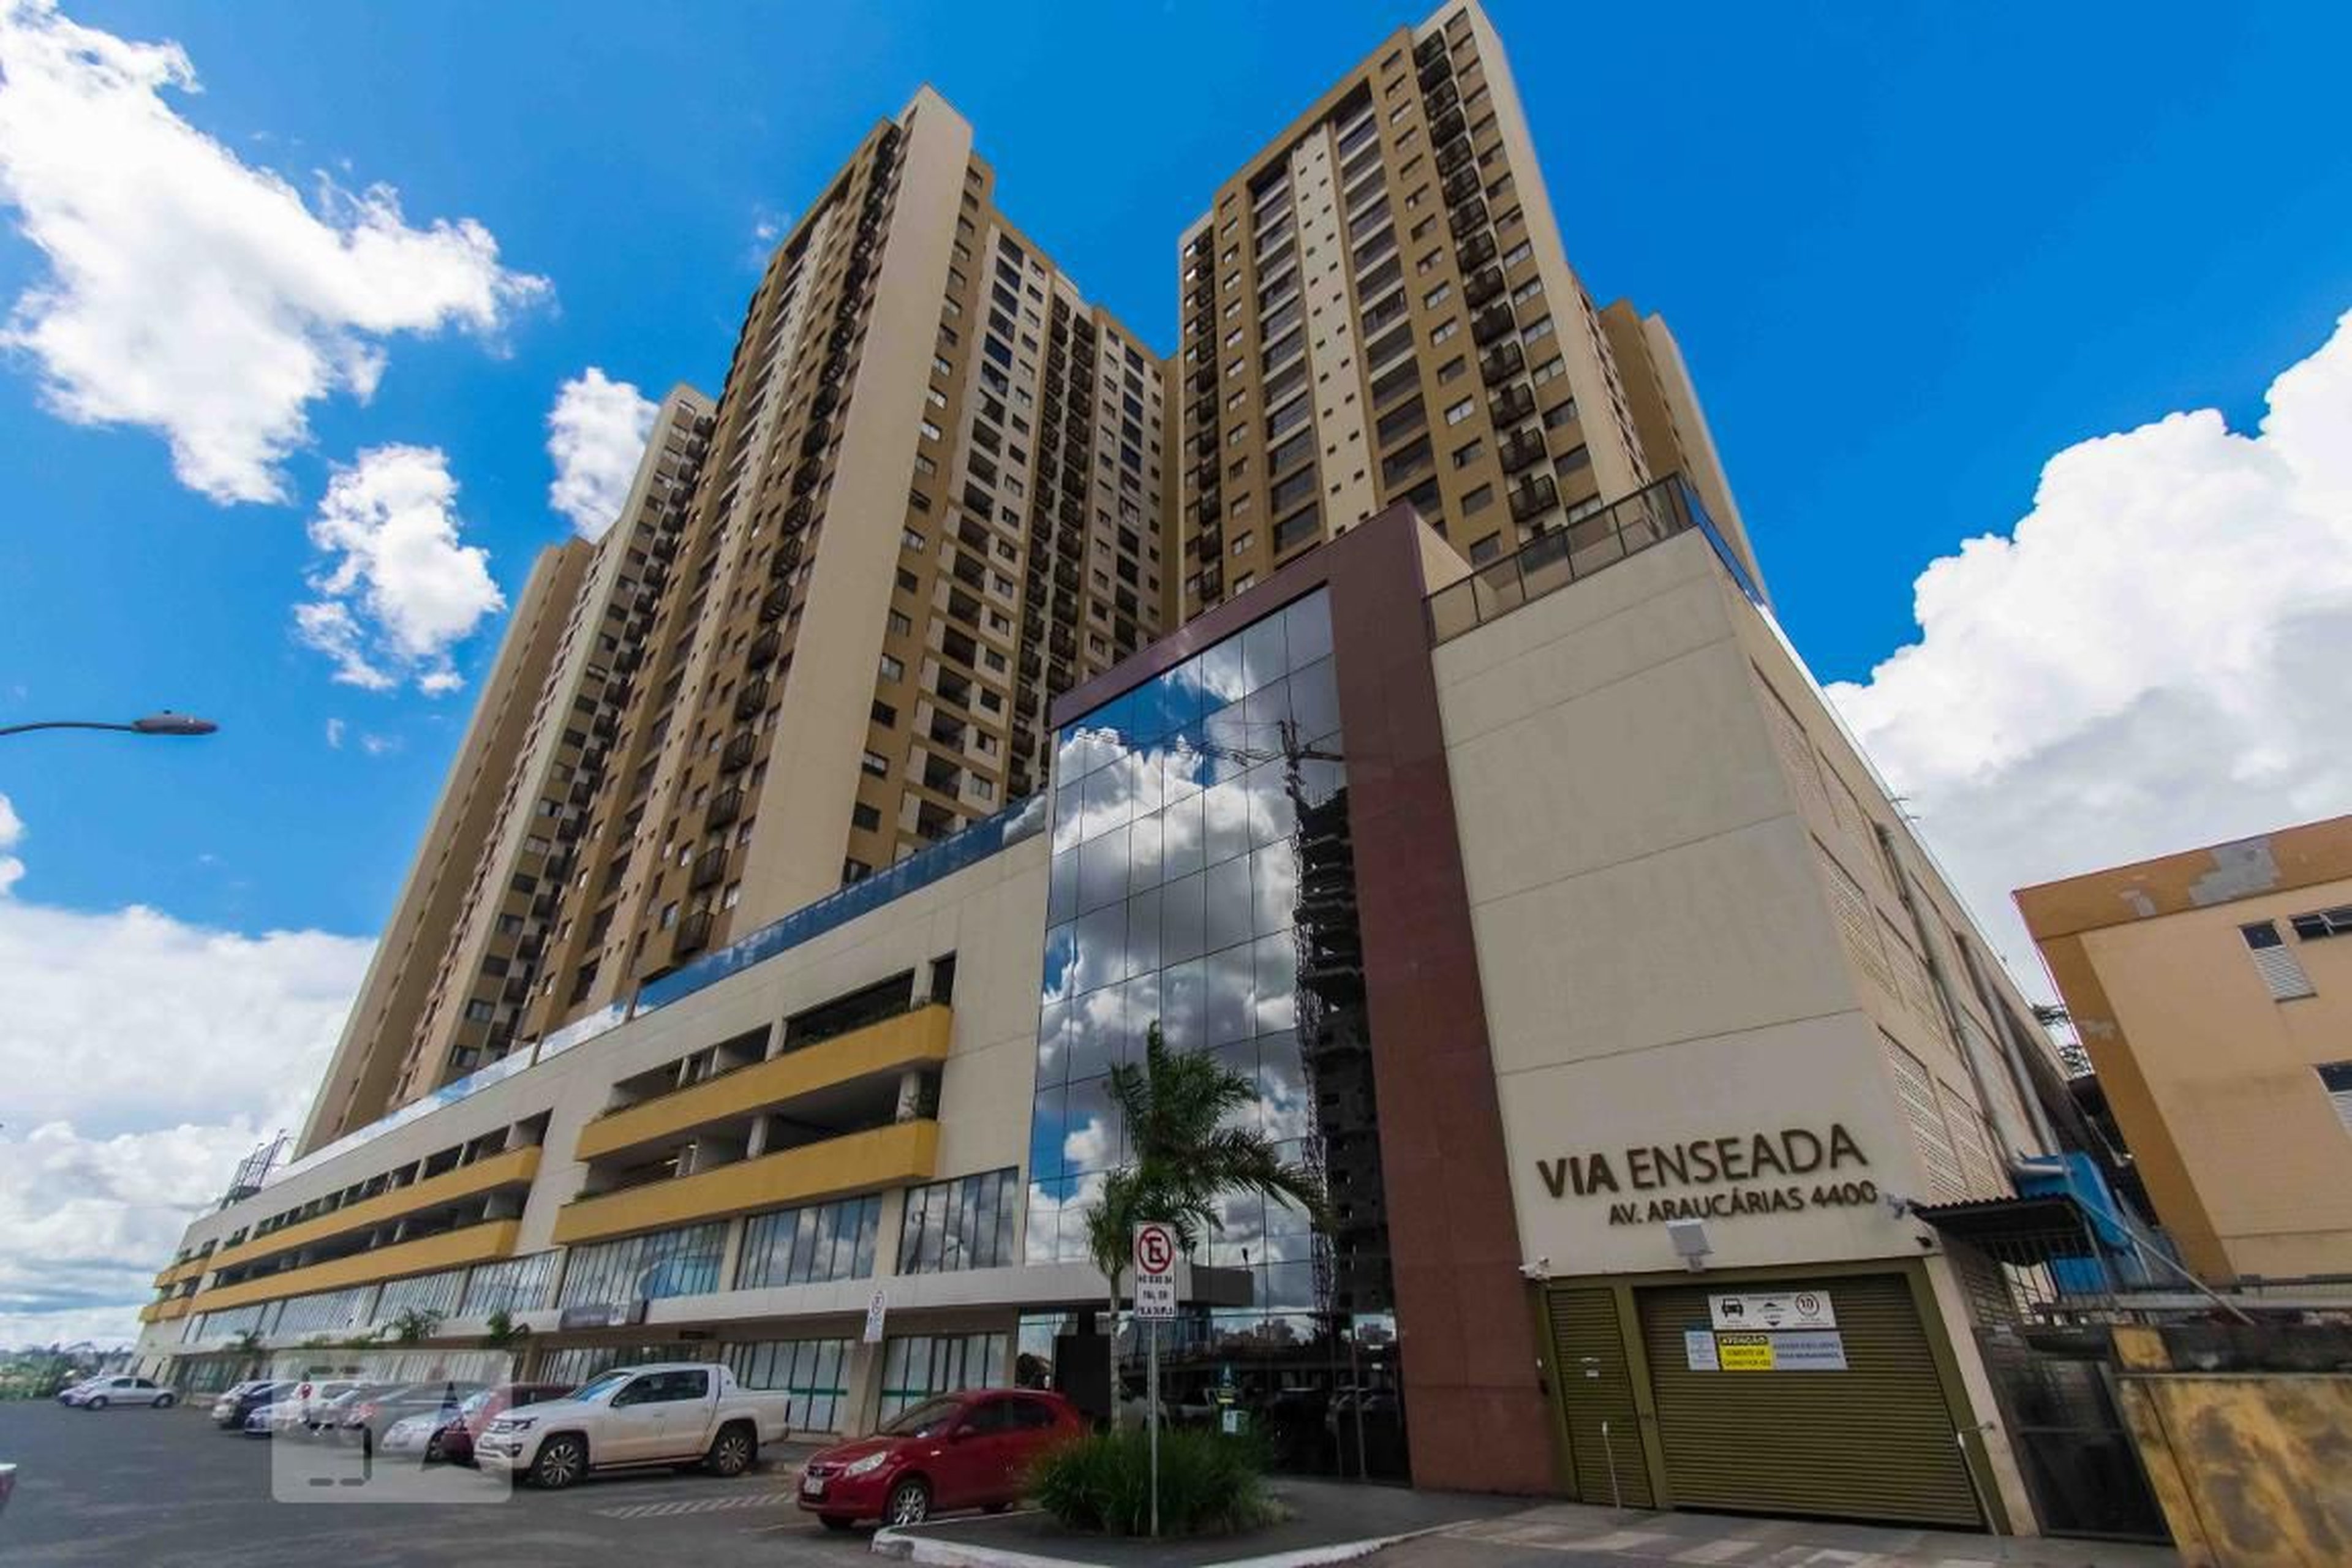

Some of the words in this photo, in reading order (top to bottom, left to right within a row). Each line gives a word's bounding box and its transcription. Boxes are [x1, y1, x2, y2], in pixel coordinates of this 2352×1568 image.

[1536, 1153, 1618, 1199] VIA
[1626, 1123, 1869, 1190] ENSEADA
[1608, 1203, 1643, 1225] AV.
[1648, 1187, 1804, 1221] ARAUCÁRIAS
[1811, 1180, 1878, 1208] 4400
